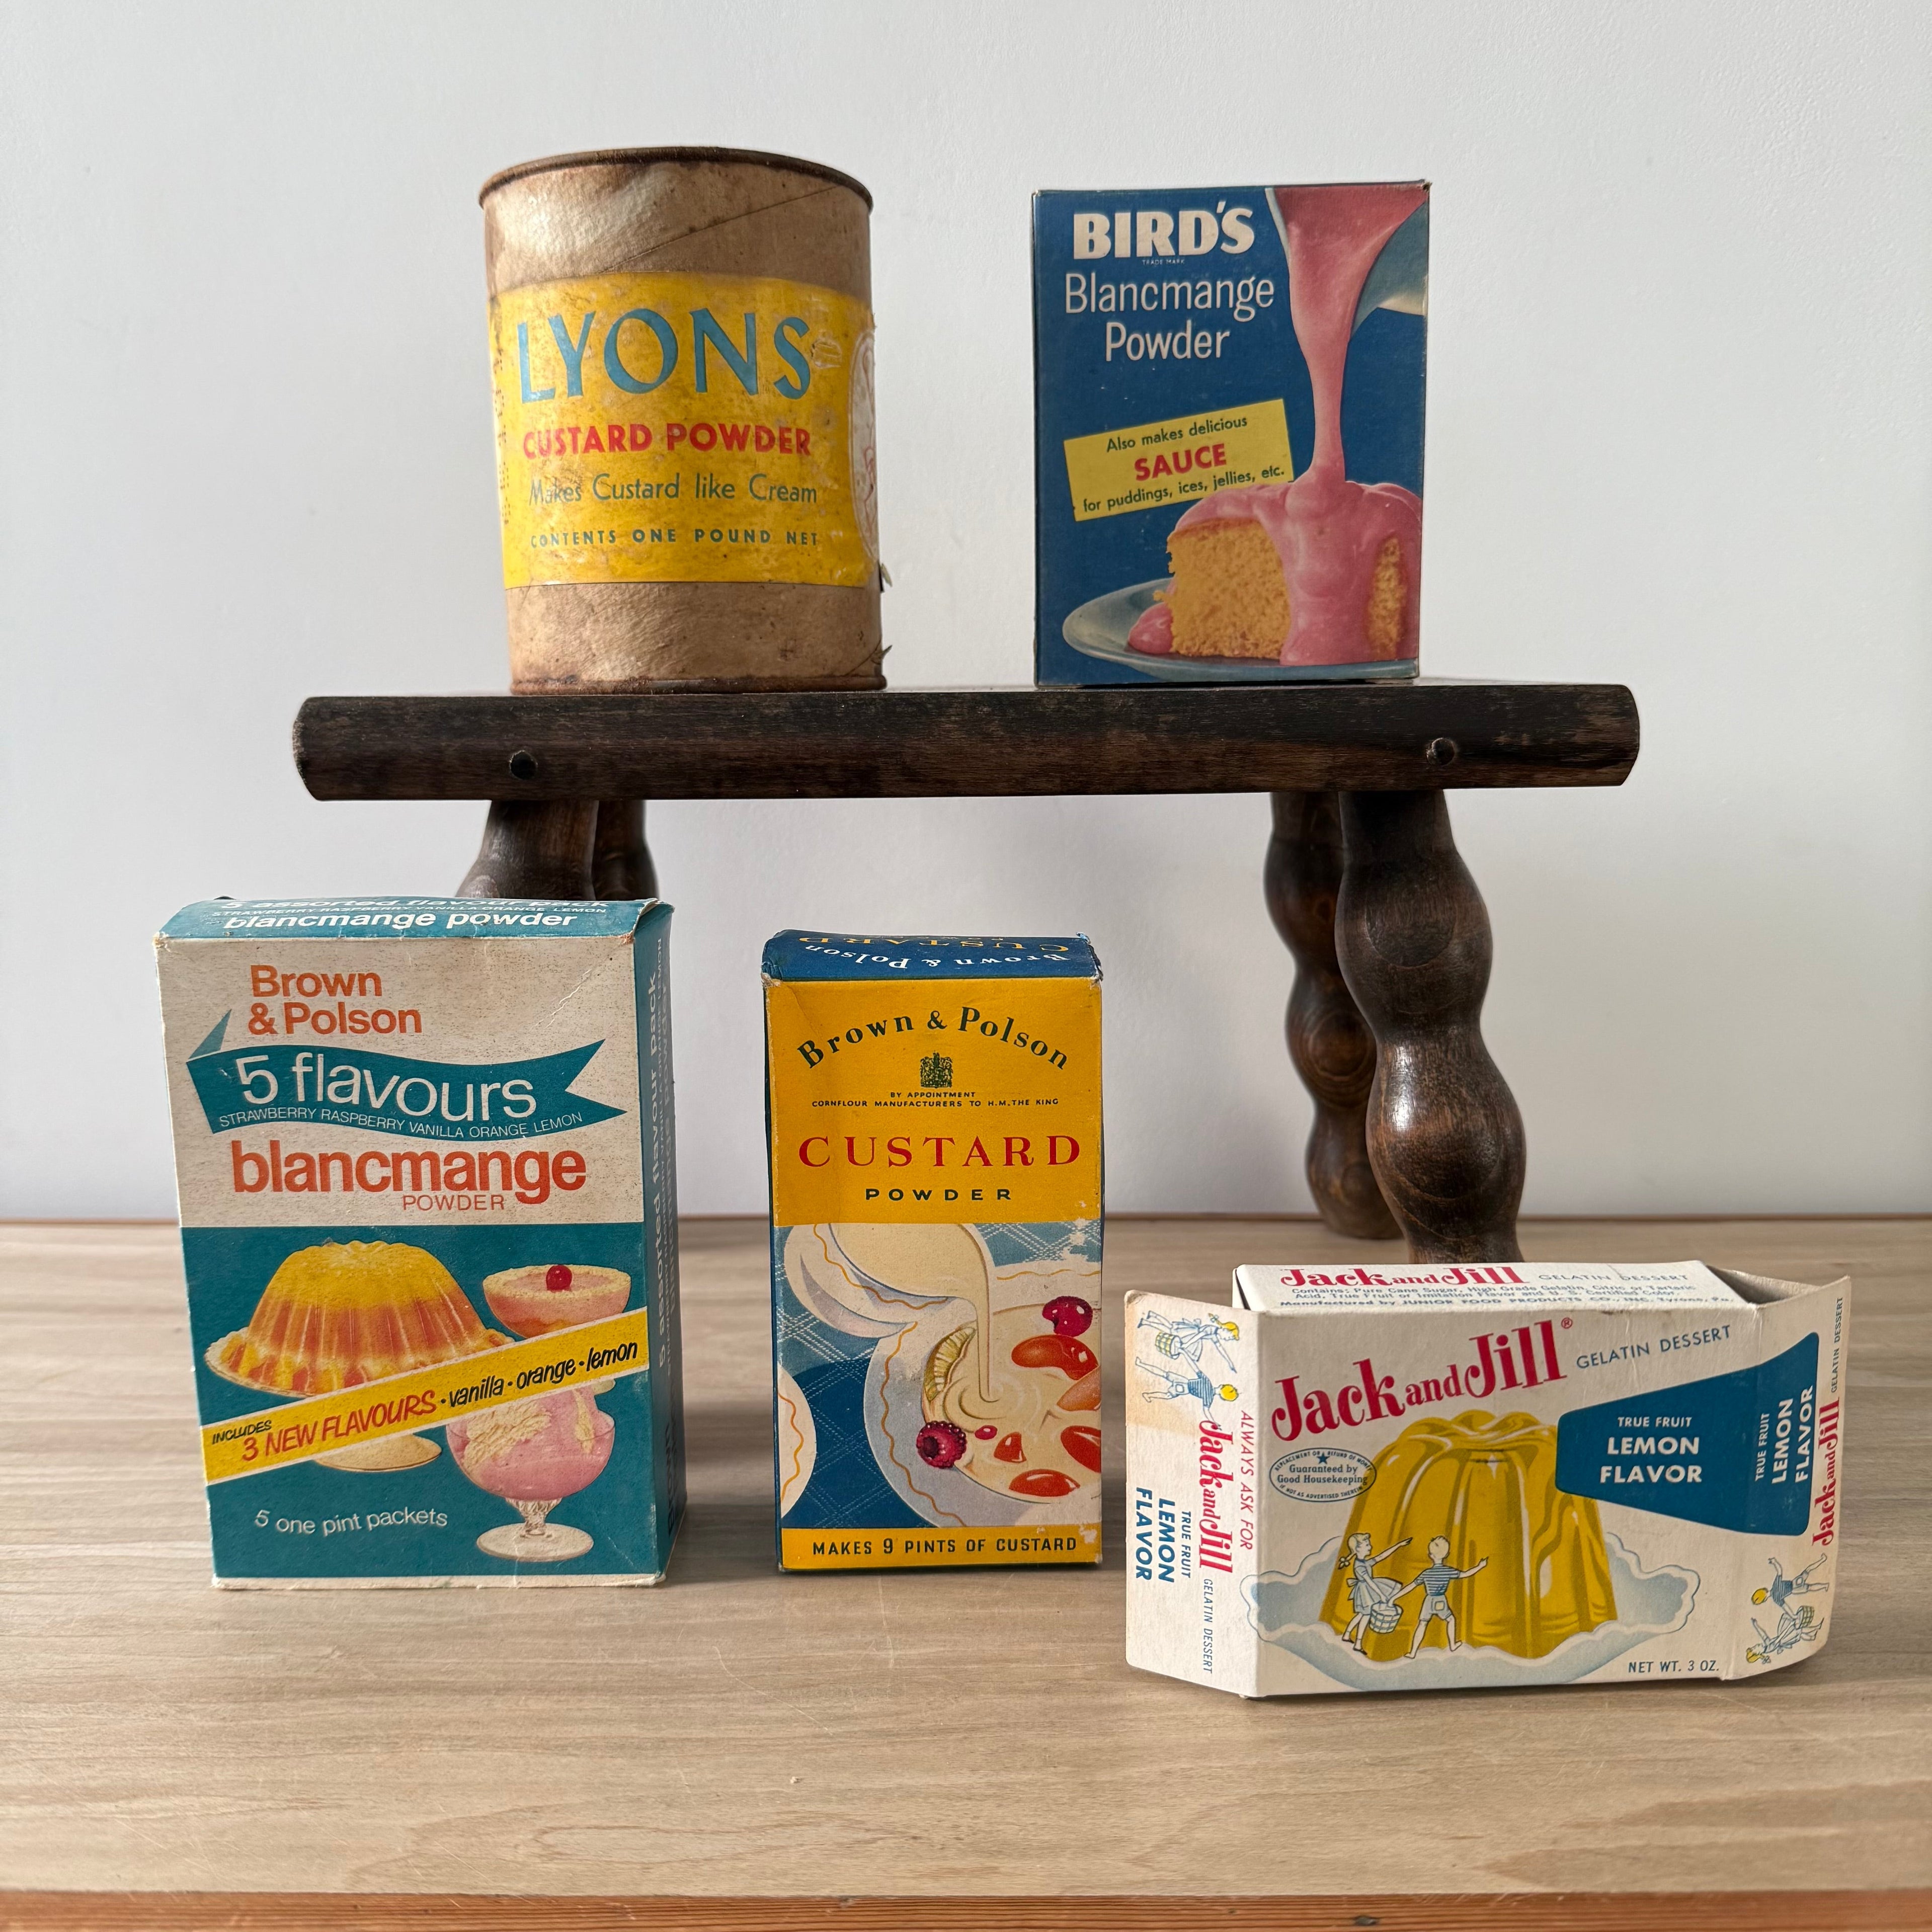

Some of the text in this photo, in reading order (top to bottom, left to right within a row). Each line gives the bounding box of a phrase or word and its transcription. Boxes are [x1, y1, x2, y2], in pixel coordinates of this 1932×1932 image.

[1074, 201, 1255, 259] BIRD'S
[1065, 274, 1274, 322] Blancmange
[517, 307, 811, 403] LYONS
[1105, 321, 1230, 361] Powder
[523, 423, 812, 459] CUSTARD POWDER
[1107, 415, 1247, 453] Also makes delicious
[1135, 444, 1227, 480] SAUCE
[529, 473, 817, 506] Makes Custard like Cream
[1083, 465, 1285, 512] for puddings, ices, jellies, etc.
[531, 529, 818, 547] CONTENTS ONE POUND NET
[212, 908, 317, 916] STRAWBERRY
[223, 913, 577, 929] blancmange powder
[253, 900, 399, 908] assorted
[799, 937, 1069, 952] CUSTARD
[806, 945, 1071, 969] Brown & Polson
[251, 965, 381, 997] Brown
[249, 1002, 422, 1034] & Polson
[797, 1006, 1068, 1070] Brown & Polson
[236, 1052, 536, 1120] 5 flavours
[219, 1106, 583, 1138] STRAWBERRY RASPBERRY VANILLA ORANGE LEMON
[799, 1135, 1080, 1168] CUSTARD
[232, 1140, 586, 1204] blancmange
[648, 972, 666, 1368] 5 assorted flavour pack
[402, 1194, 505, 1211] POWDER
[865, 1188, 1012, 1201] POWDER
[1280, 1266, 1530, 1286] Jack and Jill
[1577, 1325, 1731, 1370] GELATIN DESSERT
[1830, 1297, 1844, 1393] GELATIN DESSERT
[1271, 1319, 1567, 1442] Jack and Jill
[242, 1341, 638, 1461] 3 NEW FLAVOURS vanilla orange lemon
[212, 1420, 272, 1445] INCLUDES
[1618, 1416, 1692, 1428] TRUE FRUIT
[1795, 1385, 1814, 1483] FLAVOR
[1607, 1437, 1700, 1456] LEMON
[1754, 1413, 1770, 1482] TRUE FRUIT
[1771, 1398, 1794, 1485] LEMON
[1274, 1452, 1310, 1471] REPLACEMENT
[1356, 1457, 1373, 1472] MONEY
[1277, 1475, 1368, 1485] Good Housekeeping
[1289, 1464, 1358, 1475] Guaranteed by
[1600, 1466, 1703, 1484] FLAVOR
[1812, 1397, 1840, 1547] Jack and Jill
[1198, 1420, 1234, 1573] Jack and Jill
[1239, 1410, 1254, 1551] ALWAYS ASK FOR
[1341, 1486, 1363, 1497] THEREIN
[255, 1509, 448, 1537] 5 one pint packets
[1135, 1487, 1153, 1582] FLAVOR
[1157, 1499, 1175, 1583] LEMON
[813, 1537, 1077, 1555] MAKES 9 PINTS OF CUSTARD
[1181, 1511, 1192, 1579] TRUE FRUIT
[1202, 1578, 1214, 1673] GELATIN DESSERT
[1628, 1660, 1720, 1674] NET WT. 3 OZ.
